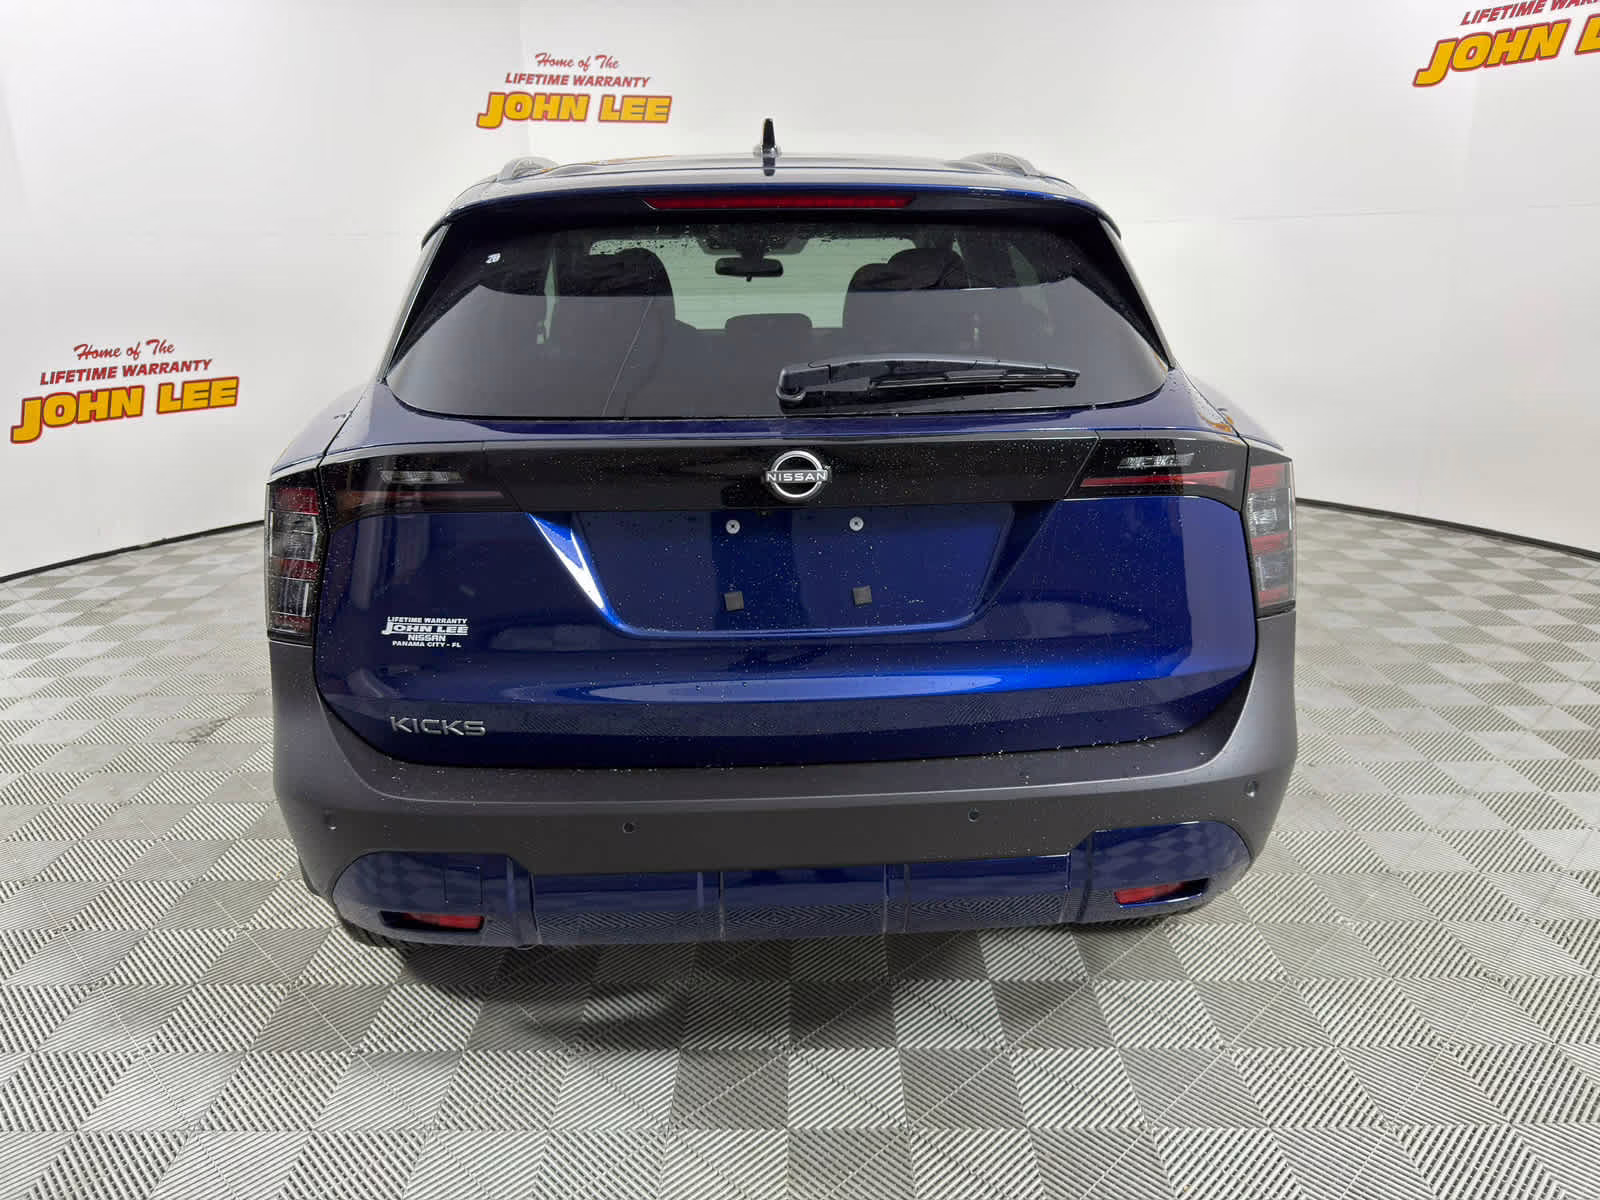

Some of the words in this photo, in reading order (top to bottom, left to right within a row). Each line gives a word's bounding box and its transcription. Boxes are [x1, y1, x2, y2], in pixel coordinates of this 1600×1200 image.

[1459, 0, 1547, 26] LIFETIME
[534, 52, 575, 68] Home
[577, 55, 591, 72] of
[594, 54, 620, 69] The
[1412, 18, 1571, 87] JOHN
[504, 72, 569, 86] LIFETIME
[573, 74, 651, 88] WARRANTY
[476, 91, 591, 129] JOHN
[598, 94, 672, 124] LEE
[73, 343, 122, 360] Home
[126, 342, 141, 360] of
[146, 339, 175, 355] The
[40, 365, 118, 385] LIFETIME
[122, 358, 213, 377] WARRANTY
[10, 385, 145, 444] JOHN
[157, 376, 239, 414] LEE
[766, 472, 827, 482] NISSAN
[381, 622, 433, 635] JOHN
[436, 626, 469, 634] LEE
[407, 634, 446, 642] NISSAN
[389, 716, 486, 736] KICKS
